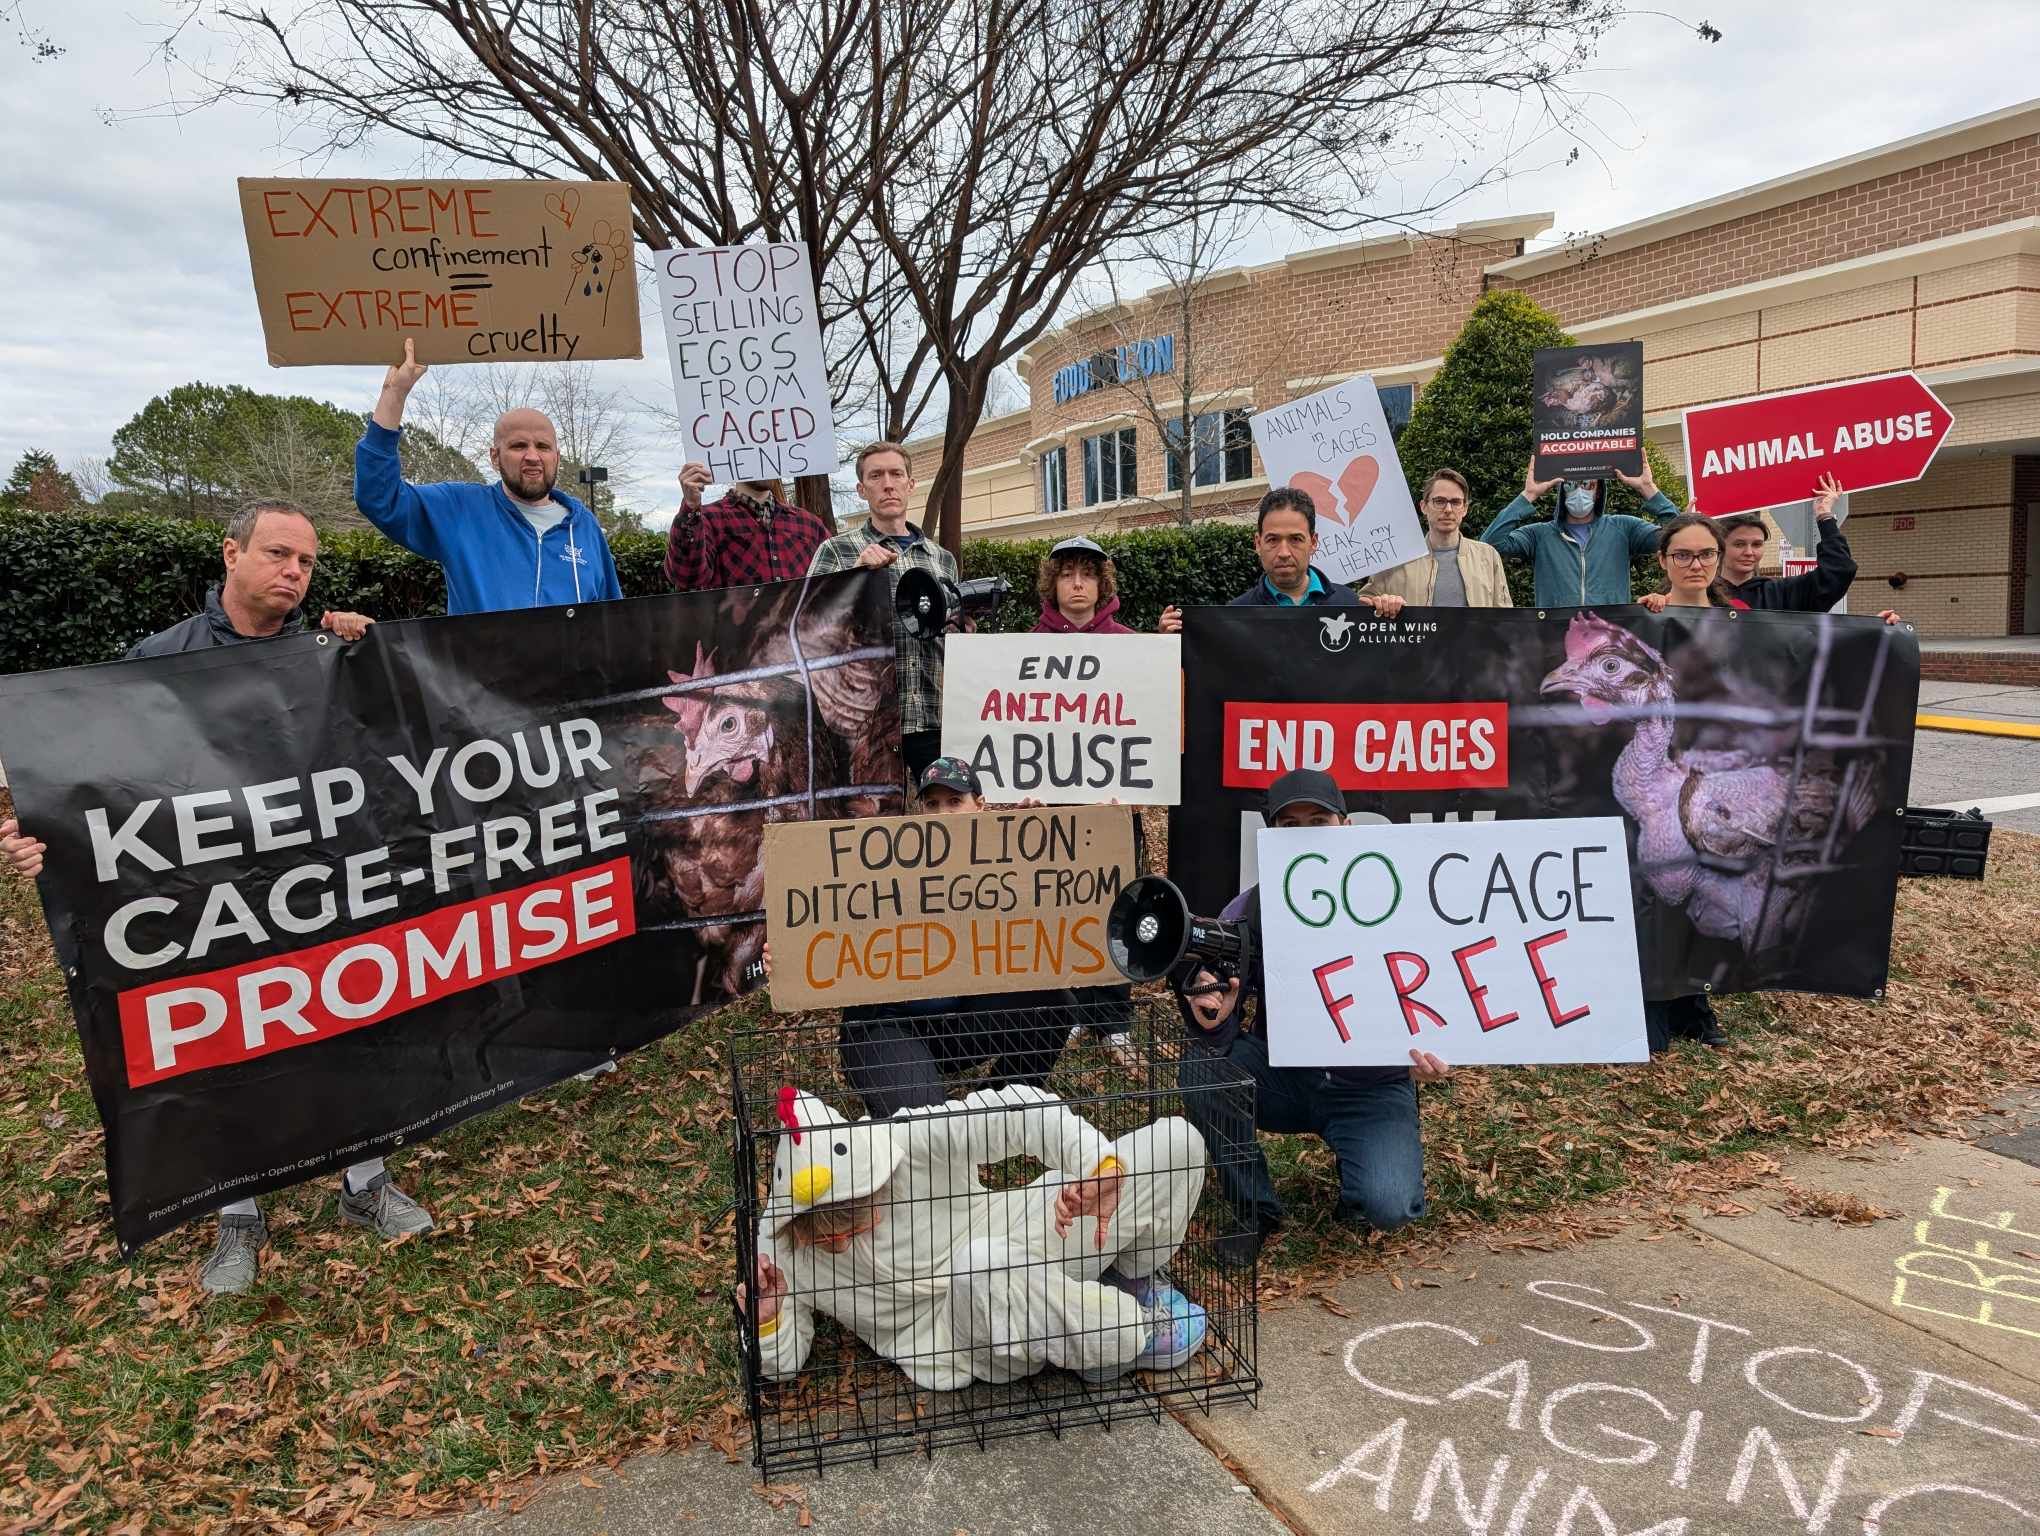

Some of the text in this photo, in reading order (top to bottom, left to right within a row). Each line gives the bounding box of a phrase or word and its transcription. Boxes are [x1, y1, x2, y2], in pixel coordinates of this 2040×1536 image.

[263, 186, 499, 238] EXTREME
[372, 225, 553, 277] confinement
[666, 245, 800, 298] STOP
[286, 289, 480, 332] EXTREME
[672, 295, 803, 337] SELLING
[467, 313, 580, 360] cruelty
[679, 332, 797, 379] EGGS
[700, 372, 806, 409] FROM
[1053, 333, 1175, 406] FOOD LION
[692, 406, 816, 448] CAGED
[1265, 390, 1352, 441] ANIMALS
[1311, 431, 1325, 443] in
[1540, 427, 1636, 441] HOLD COMPANIES
[707, 443, 809, 482] HENS
[1317, 422, 1377, 463] CAGES
[1542, 439, 1634, 453] ACCOUNTABLE
[1701, 411, 1933, 478] ANIMAL ABUSE
[1338, 535, 1398, 576] HEART
[1370, 524, 1391, 540] my
[1786, 564, 1802, 577] TOW
[1358, 622, 1437, 632] OPEN WING
[1018, 655, 1101, 681] END
[980, 688, 1137, 726] ANIMAL
[971, 732, 1153, 790] ABUSE
[1239, 718, 1496, 773] END CAGES
[85, 718, 612, 882] KEEP YOUR
[829, 815, 1092, 878] FOOD LION:
[104, 787, 627, 970] CAGE-FREE
[786, 865, 1121, 928] DITCH EGGS FROM
[1283, 850, 1402, 928] GO
[1428, 846, 1615, 926] CAGE
[145, 871, 619, 1071] PROMISE
[806, 916, 1106, 989] CAGED HENS
[1312, 928, 1591, 1043] FREE
[148, 1202, 180, 1221] Photo:
[182, 1185, 216, 1205] Konrad
[218, 1172, 259, 1191] Lozinksi
[268, 1163, 296, 1178] Open
[297, 1153, 326, 1169] Cages
[370, 1117, 430, 1145] representative
[431, 1112, 439, 1121] of
[445, 1098, 469, 1115] typical
[470, 1088, 496, 1104] factory
[496, 1079, 514, 1092] farm
[1519, 1280, 2040, 1446] STOP
